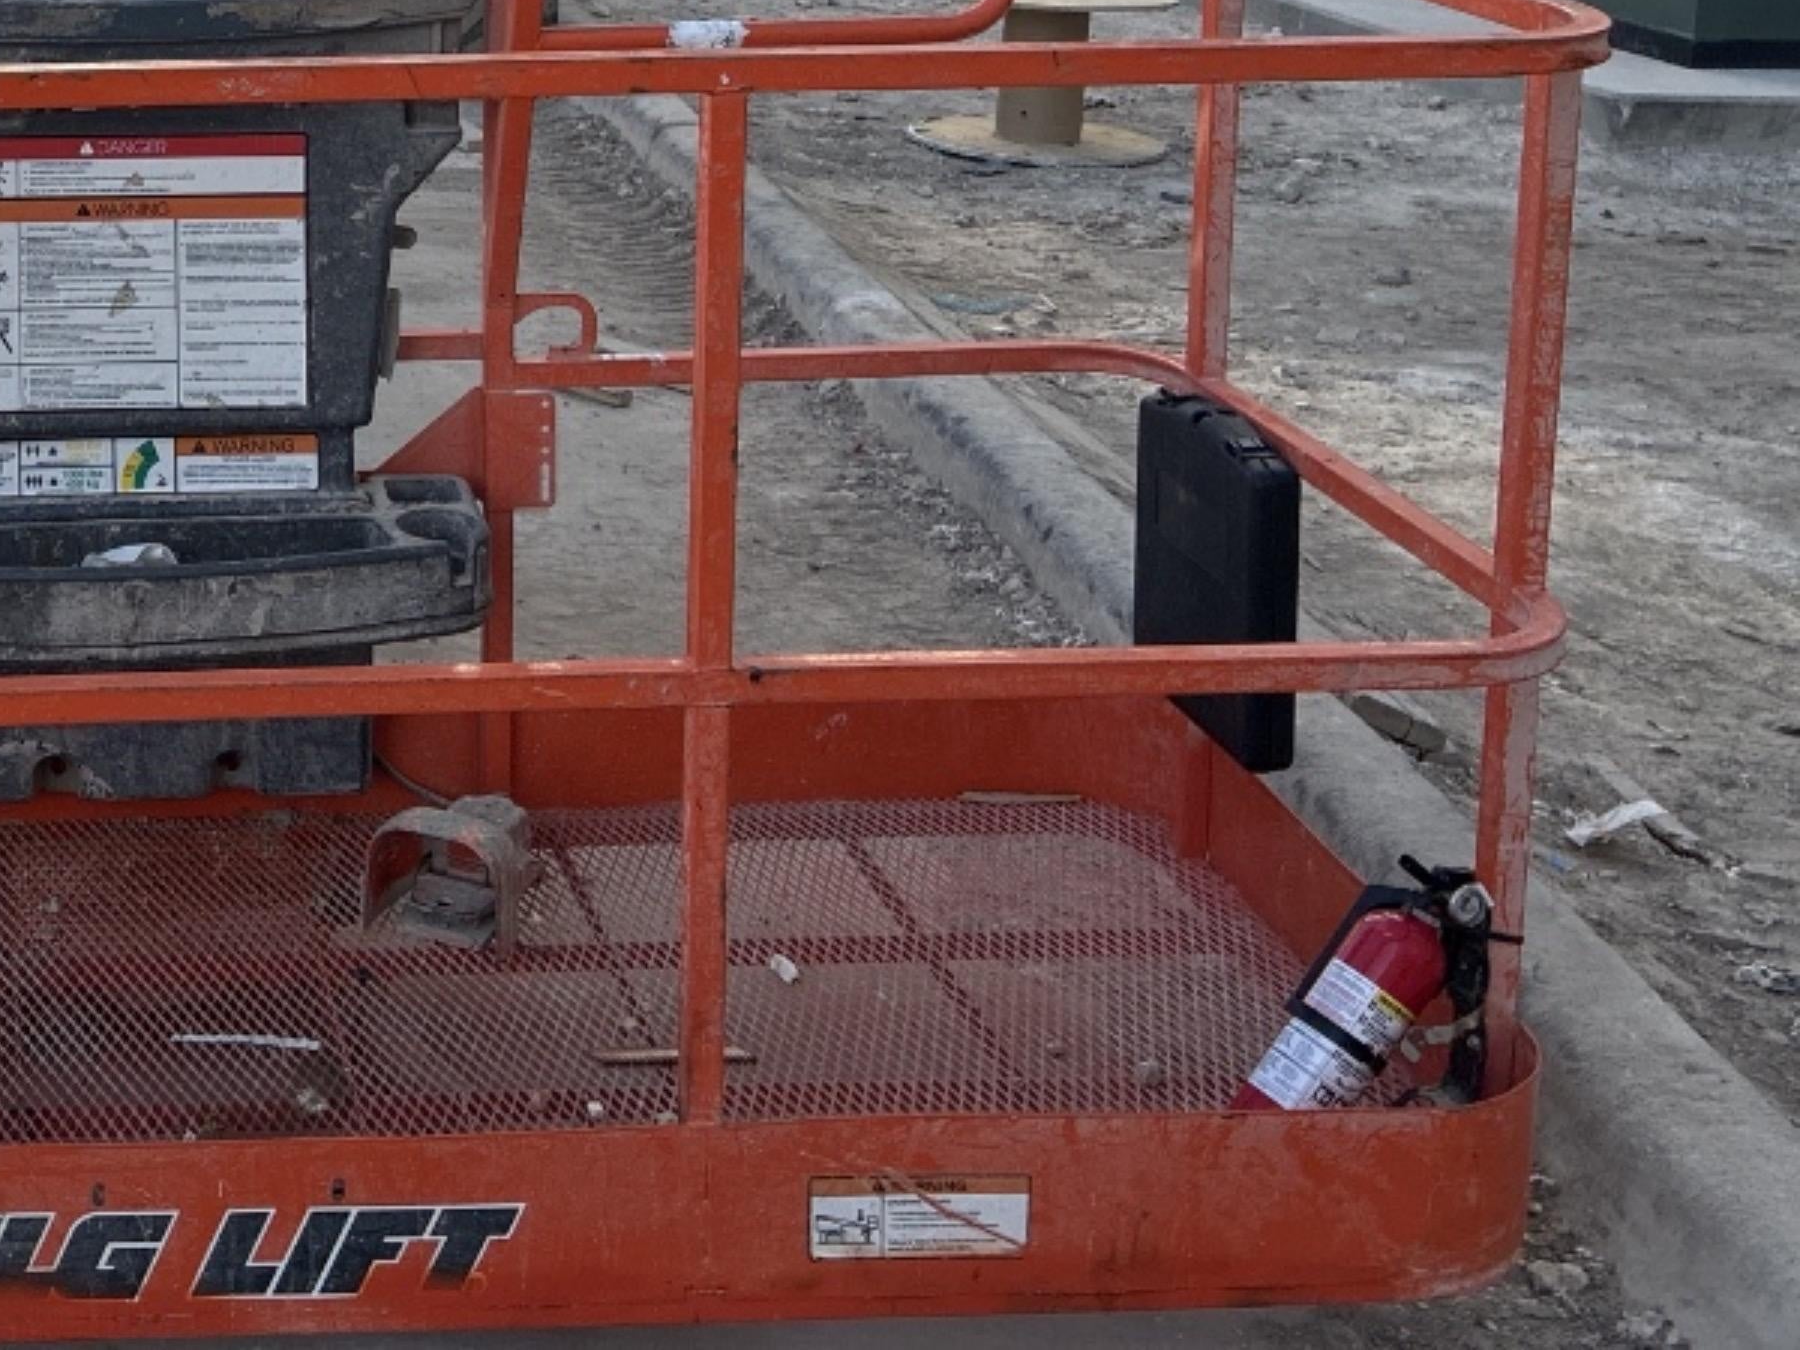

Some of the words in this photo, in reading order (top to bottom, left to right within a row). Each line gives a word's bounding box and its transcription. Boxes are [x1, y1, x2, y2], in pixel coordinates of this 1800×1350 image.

[92, 200, 169, 219] WARNING
[213, 436, 295, 455] WARNING
[189, 1202, 526, 1299] LIFT
